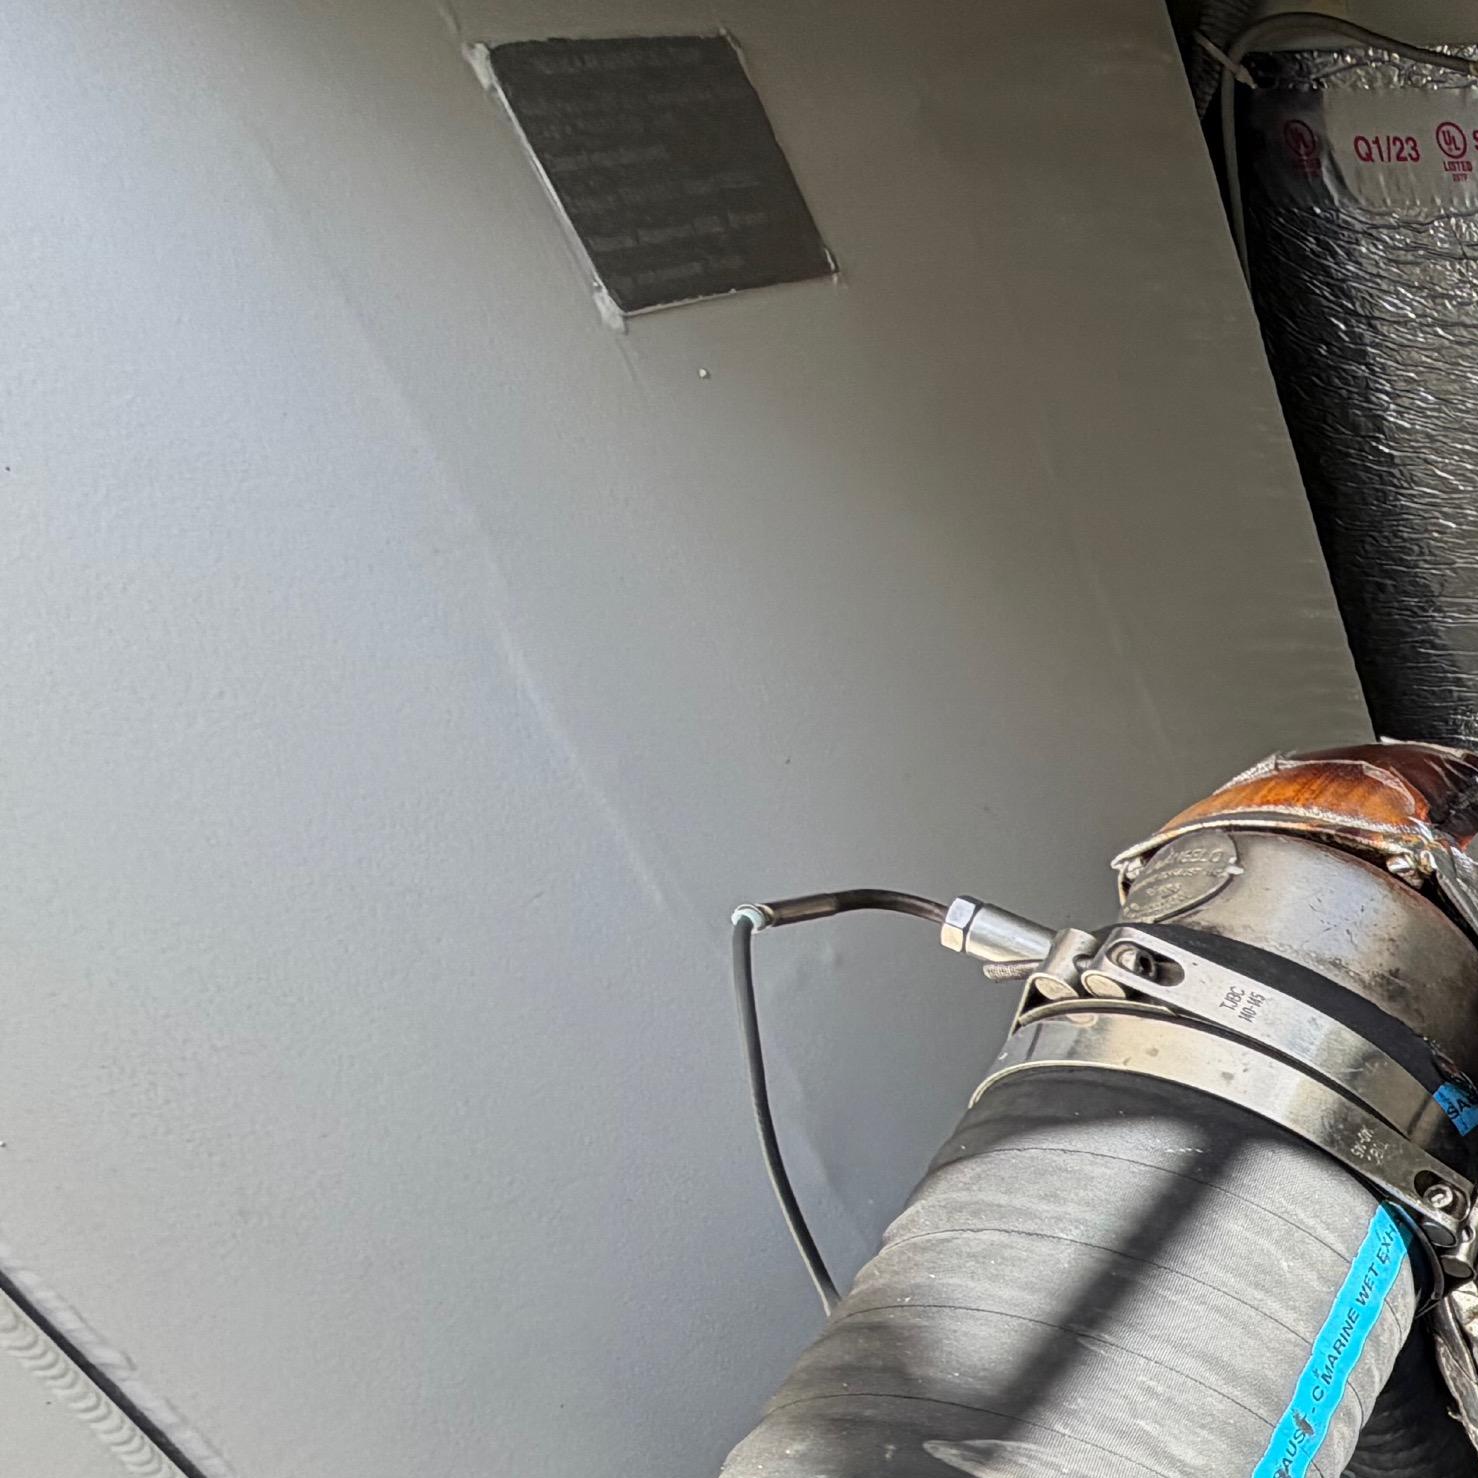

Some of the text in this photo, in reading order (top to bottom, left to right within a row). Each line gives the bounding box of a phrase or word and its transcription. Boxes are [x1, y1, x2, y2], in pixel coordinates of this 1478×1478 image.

[1354, 136, 1420, 163] Q1/23
[1443, 160, 1473, 172] LISTED
[1320, 1307, 1360, 1384] MARINE
[1355, 1263, 1382, 1306] WET
